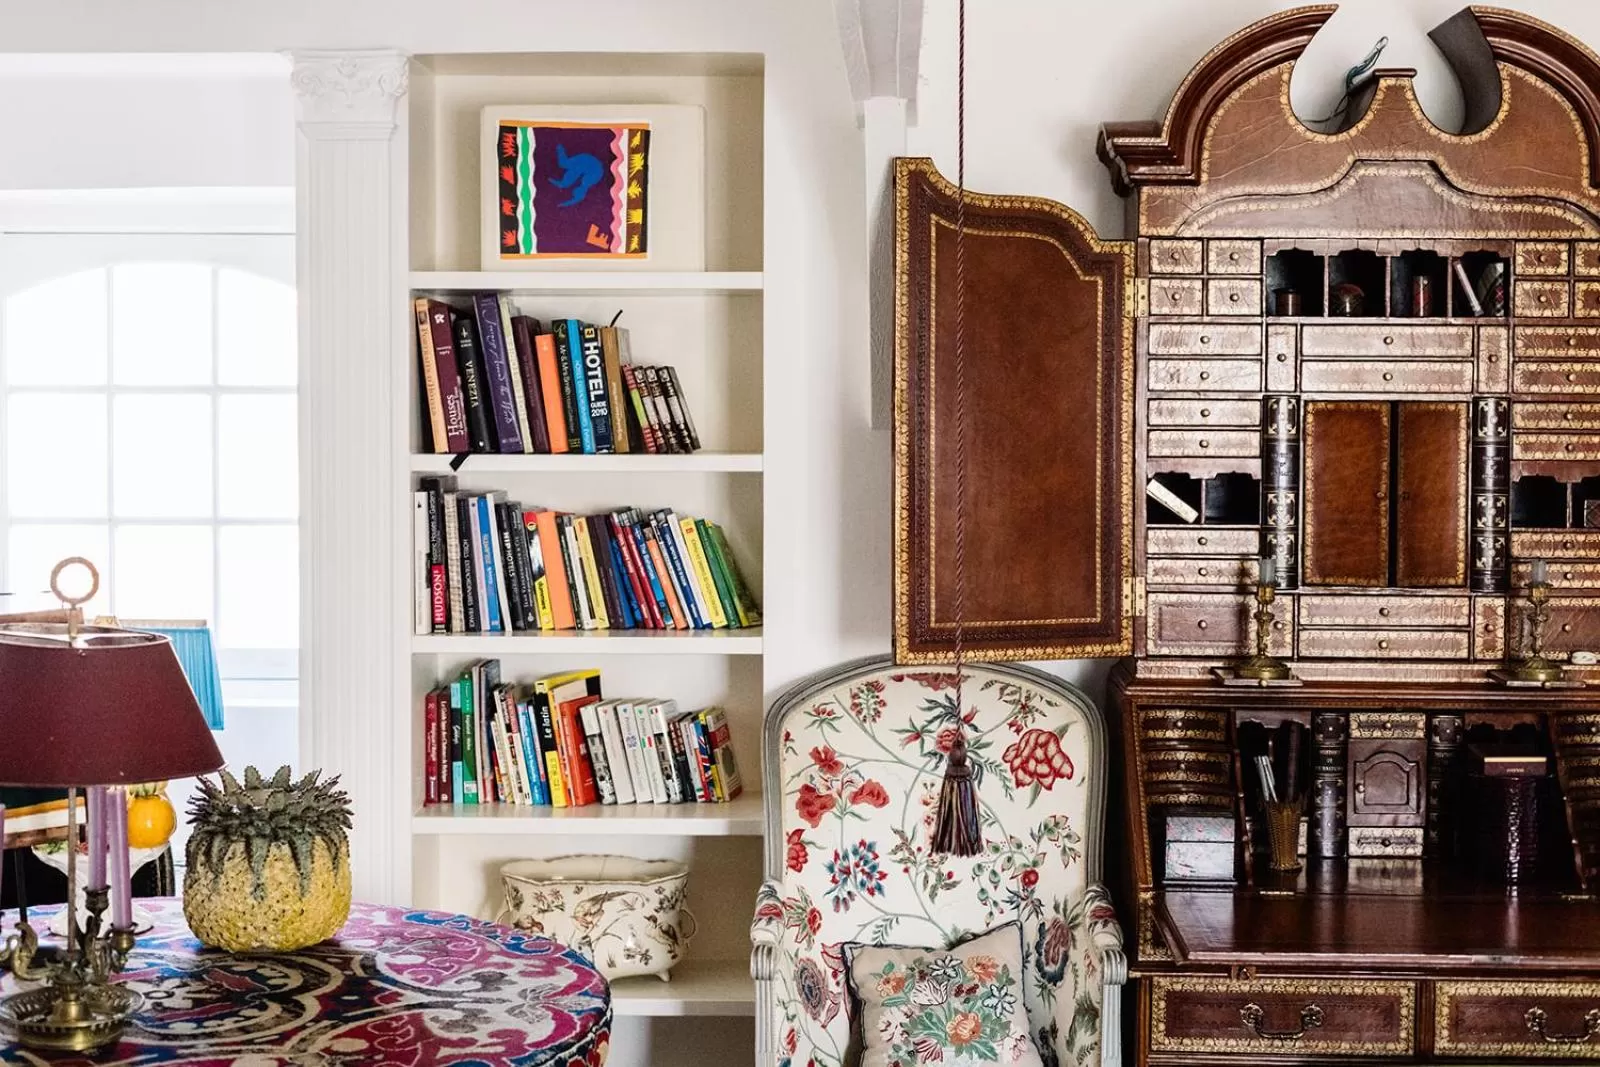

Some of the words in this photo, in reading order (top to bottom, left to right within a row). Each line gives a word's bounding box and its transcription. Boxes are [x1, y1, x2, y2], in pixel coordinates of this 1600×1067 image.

[560, 345, 566, 354] Mr
[466, 361, 478, 407] VENEZIA
[585, 342, 604, 401] HOTEL
[447, 395, 458, 436] Houses
[592, 407, 608, 417] 2010
[506, 549, 515, 577] HOTELS
[542, 705, 550, 727] latin
[544, 728, 552, 738] Le
